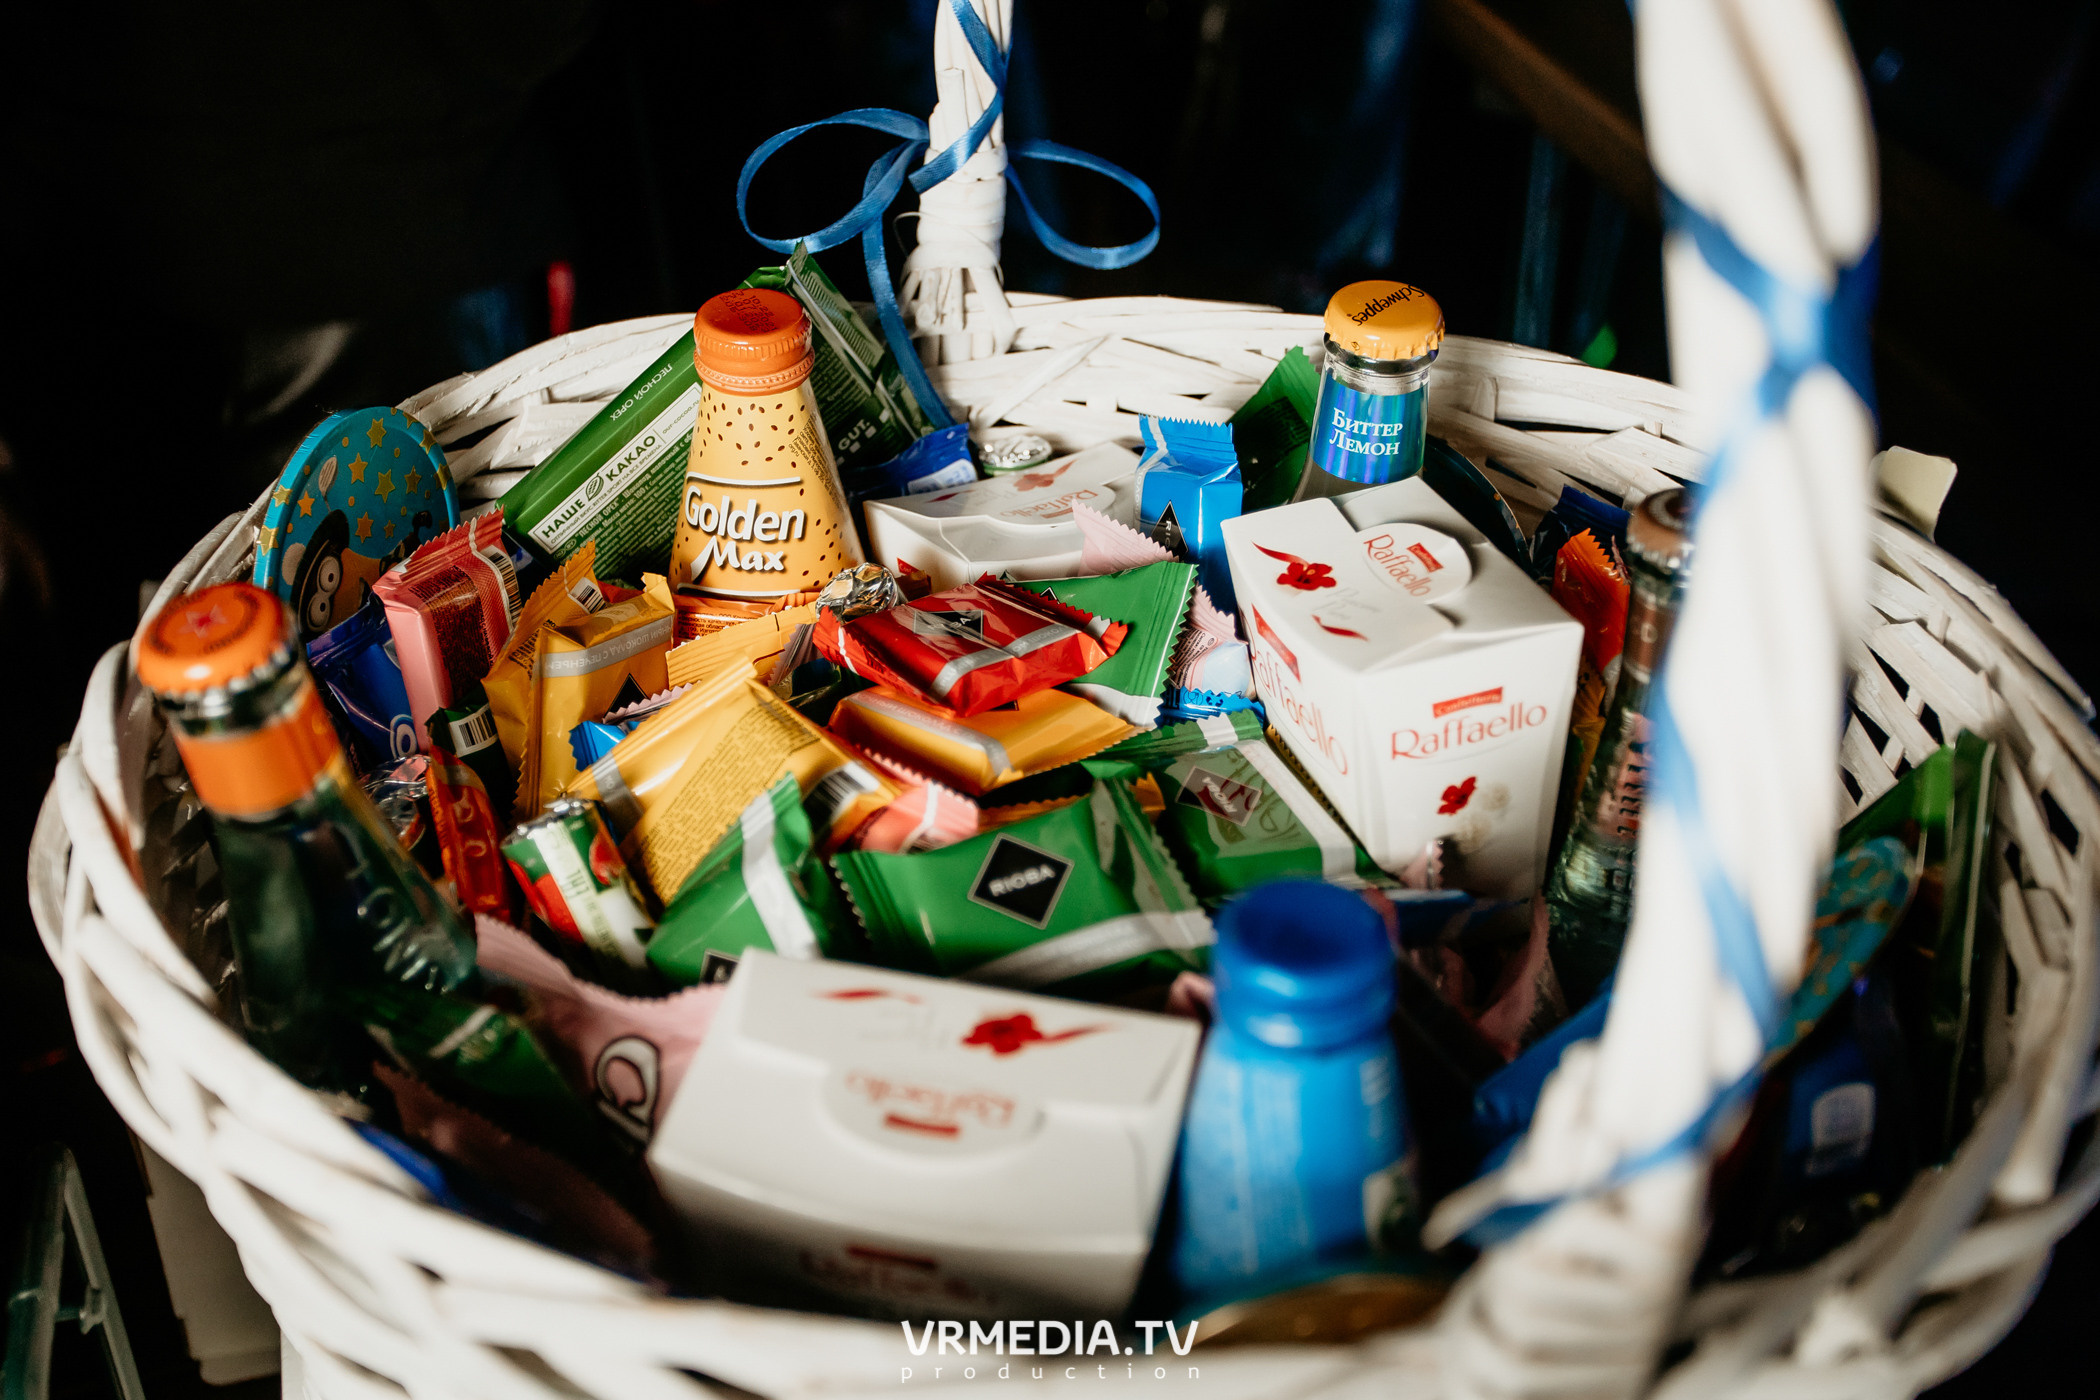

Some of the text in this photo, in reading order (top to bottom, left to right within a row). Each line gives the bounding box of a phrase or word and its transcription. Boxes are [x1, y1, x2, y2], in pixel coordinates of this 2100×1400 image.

[1351, 284, 1425, 327] Schweppes
[610, 363, 673, 421] ЛЕСНОЙ ОРЕХ
[541, 435, 656, 538] НАШЕ КАКАО
[684, 484, 806, 542] Golden
[1000, 488, 1099, 519] Raffaello
[690, 535, 785, 582] Max
[1363, 532, 1433, 598] Raffaello
[1390, 704, 1548, 761] Raffaello
[989, 862, 1056, 899] RIOBA
